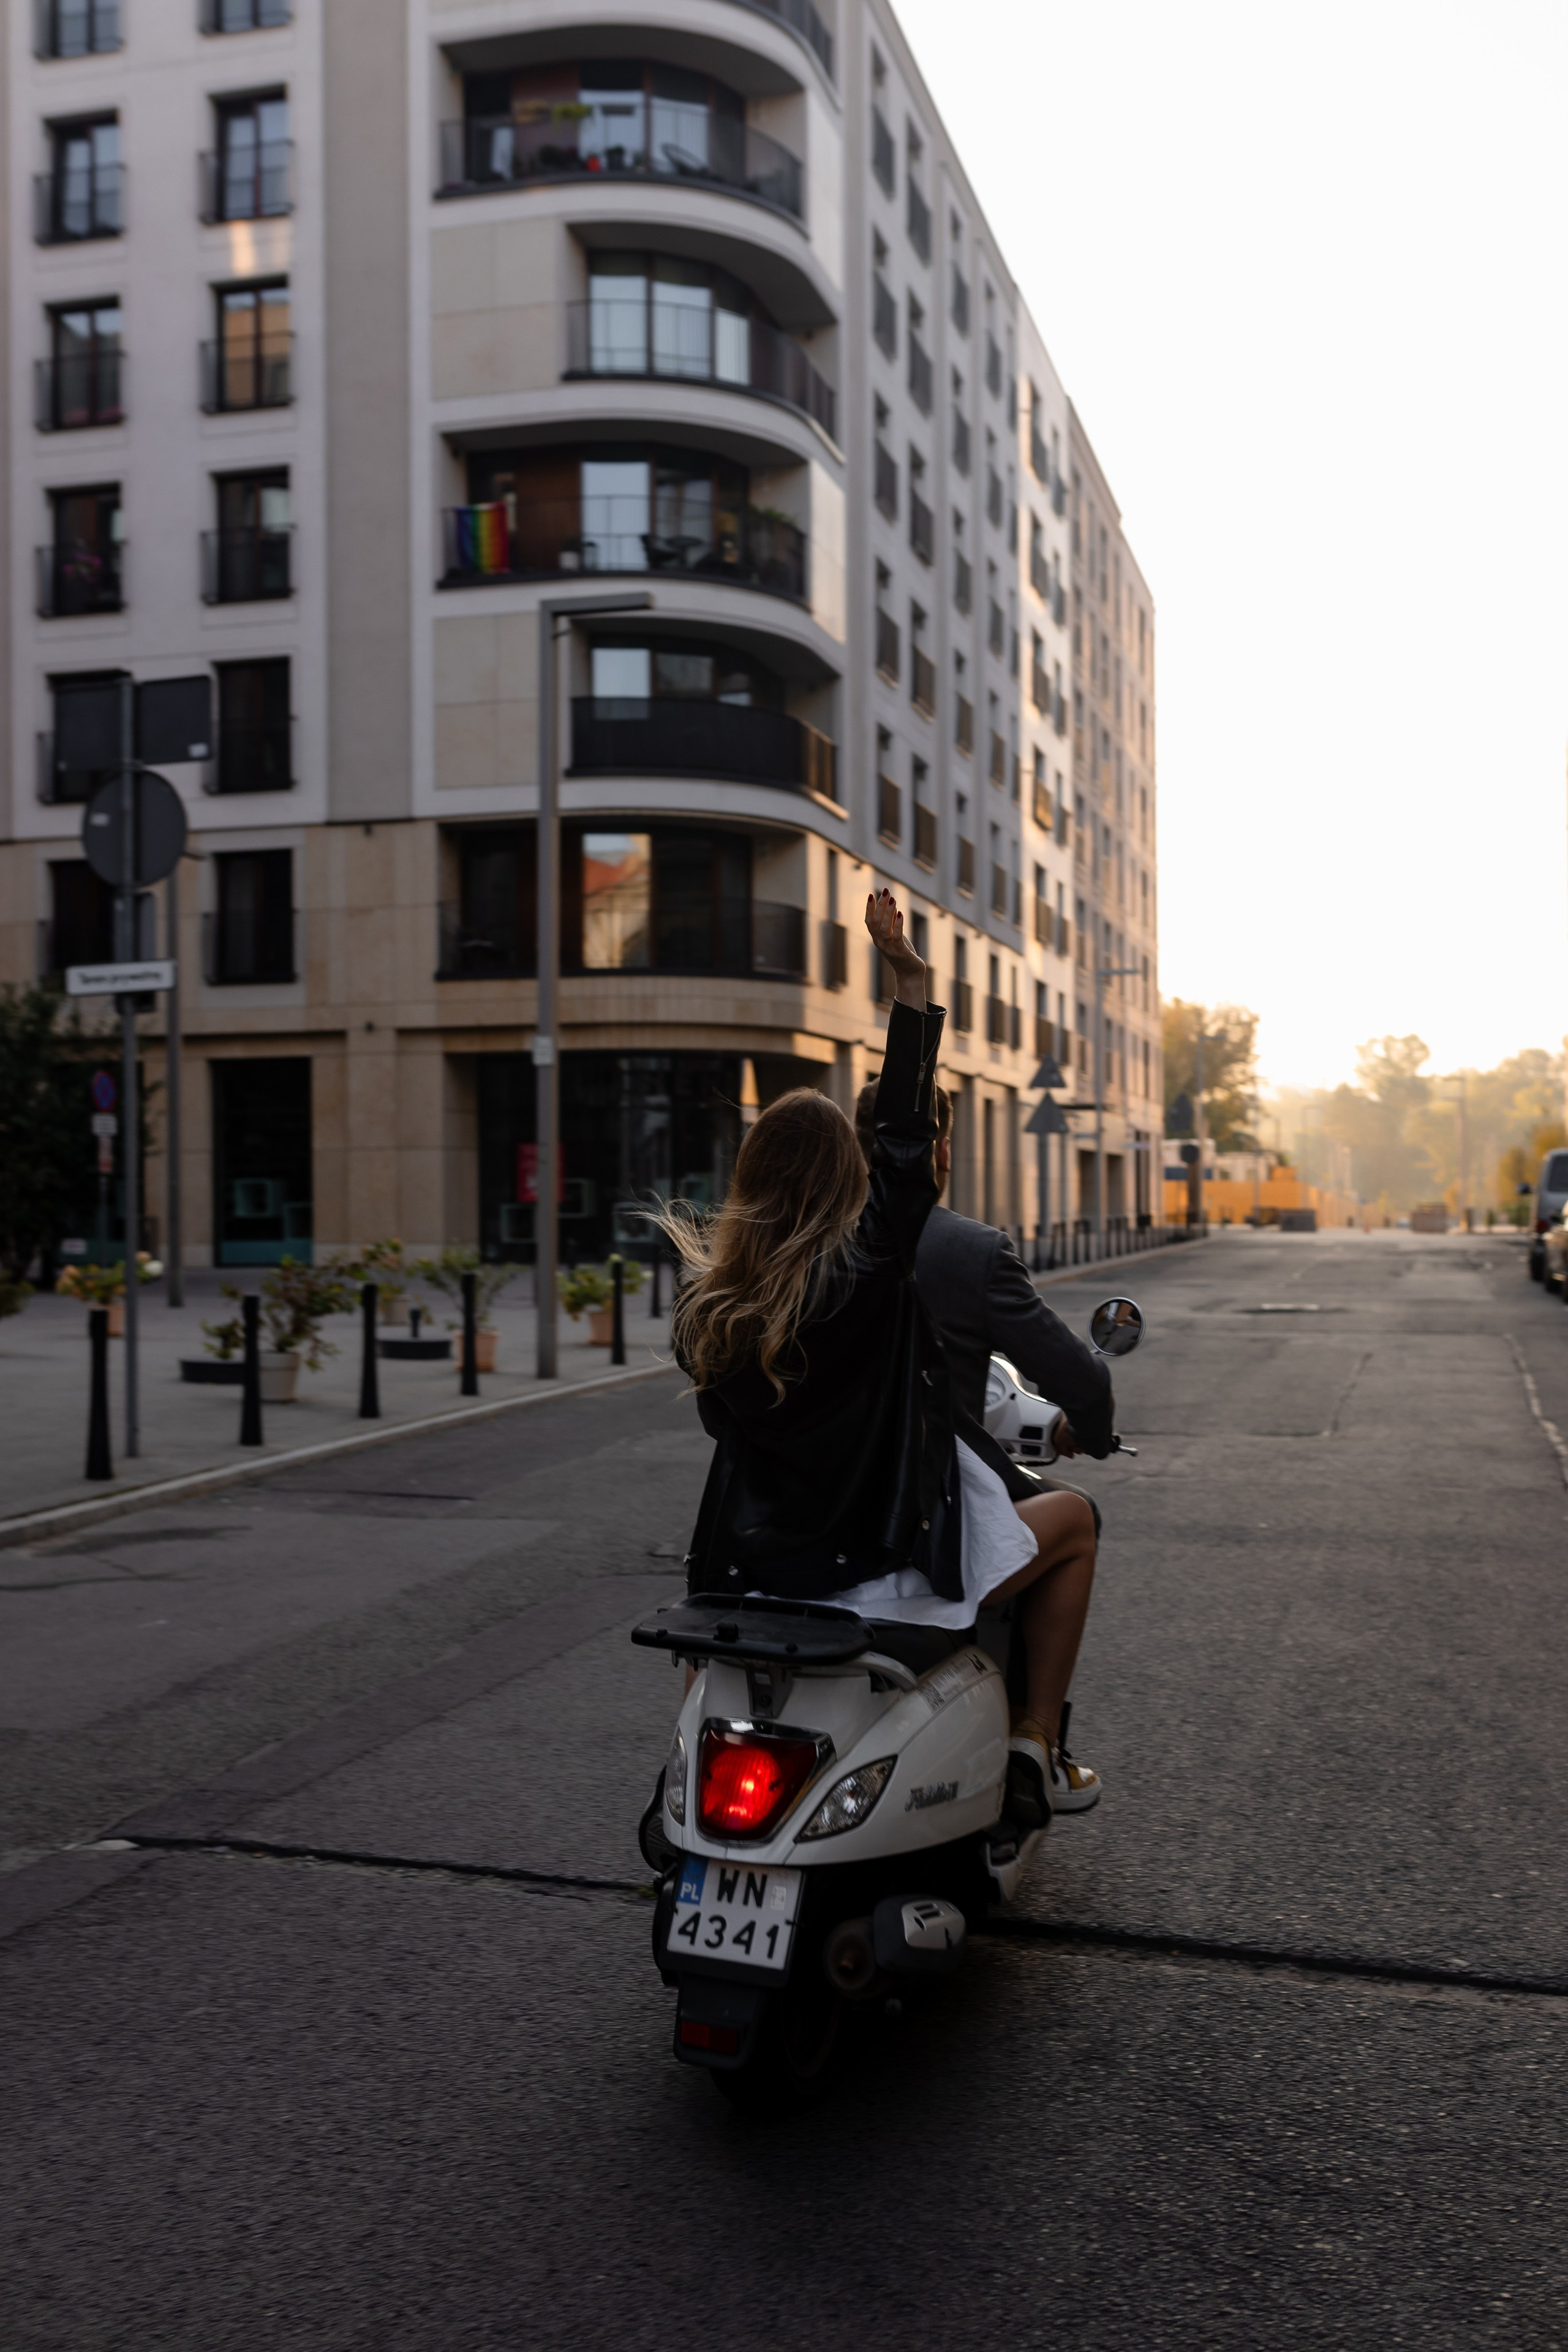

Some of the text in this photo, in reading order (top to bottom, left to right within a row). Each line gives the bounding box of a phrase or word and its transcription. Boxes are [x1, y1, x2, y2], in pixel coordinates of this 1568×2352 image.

[680, 1882, 699, 1901] PL
[717, 1868, 767, 1909] WN
[678, 1911, 779, 1959] 4341
